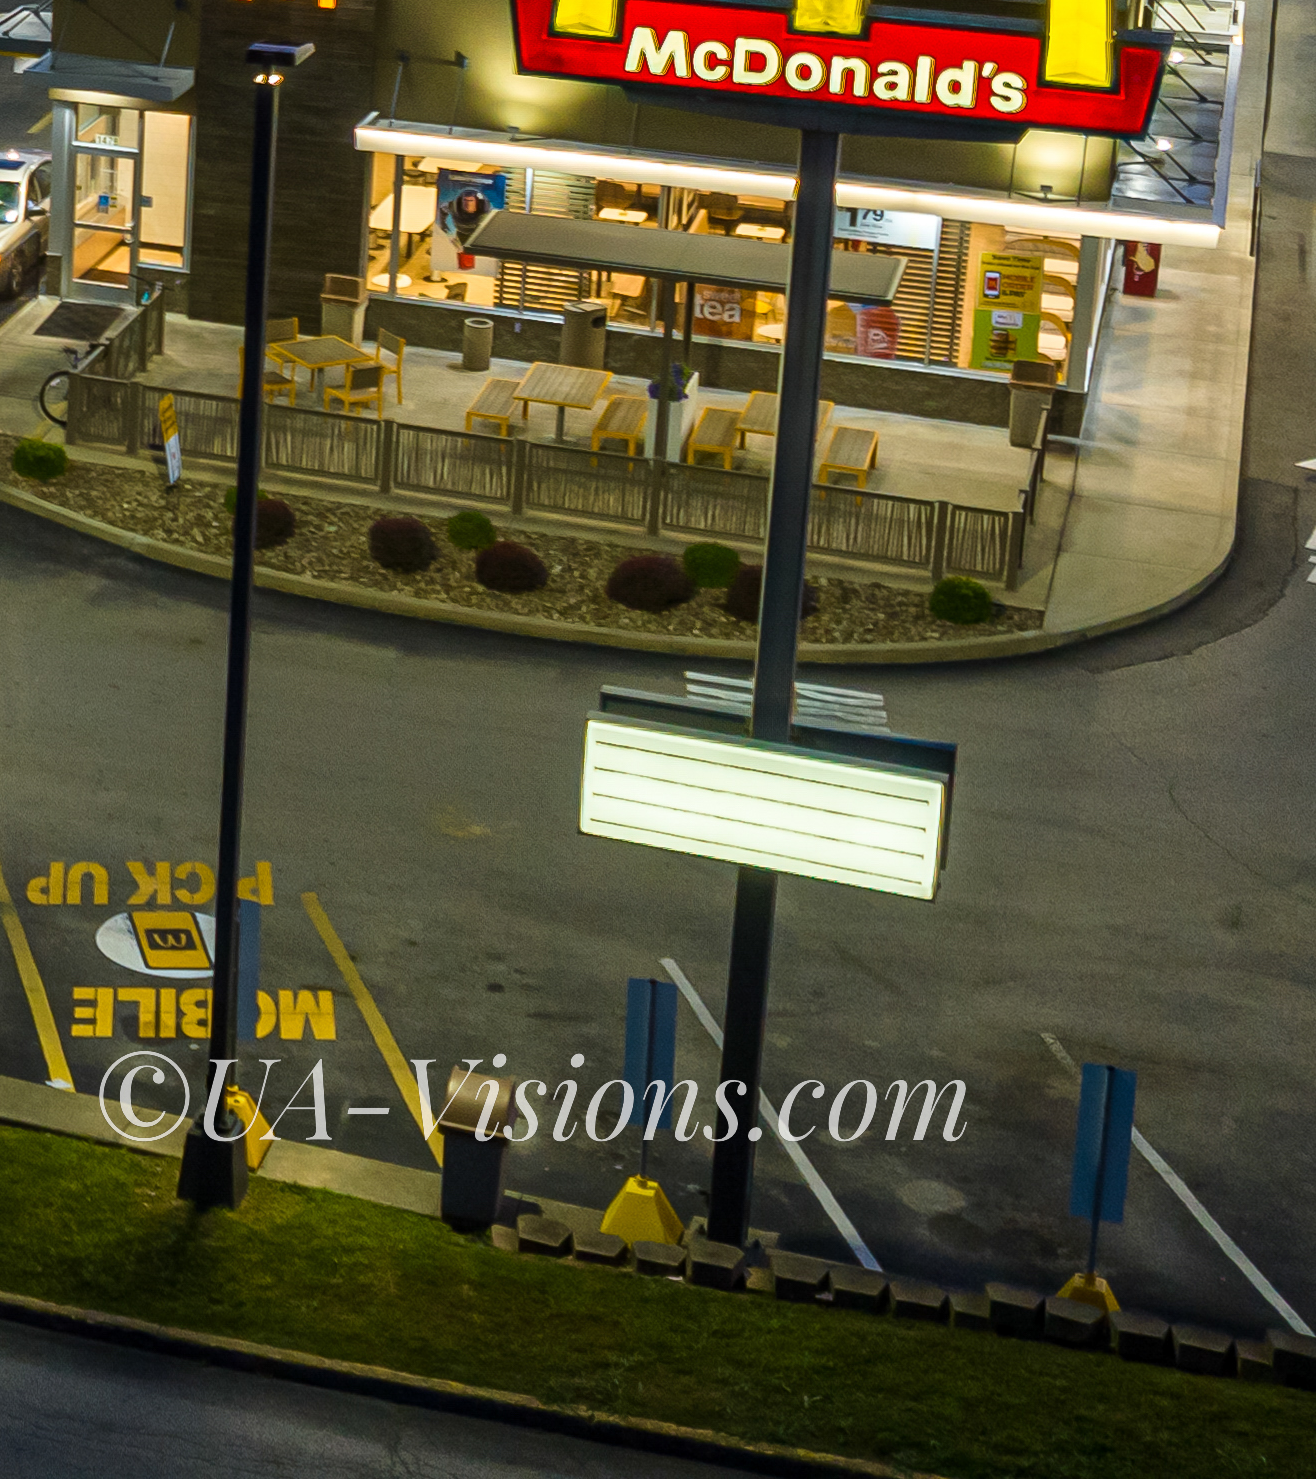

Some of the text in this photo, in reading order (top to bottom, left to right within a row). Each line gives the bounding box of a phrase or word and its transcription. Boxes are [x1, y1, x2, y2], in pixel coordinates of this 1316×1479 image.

[624, 26, 1028, 113] McDonald's
[694, 293, 741, 323] tea
[25, 860, 274, 906] PCK UP
